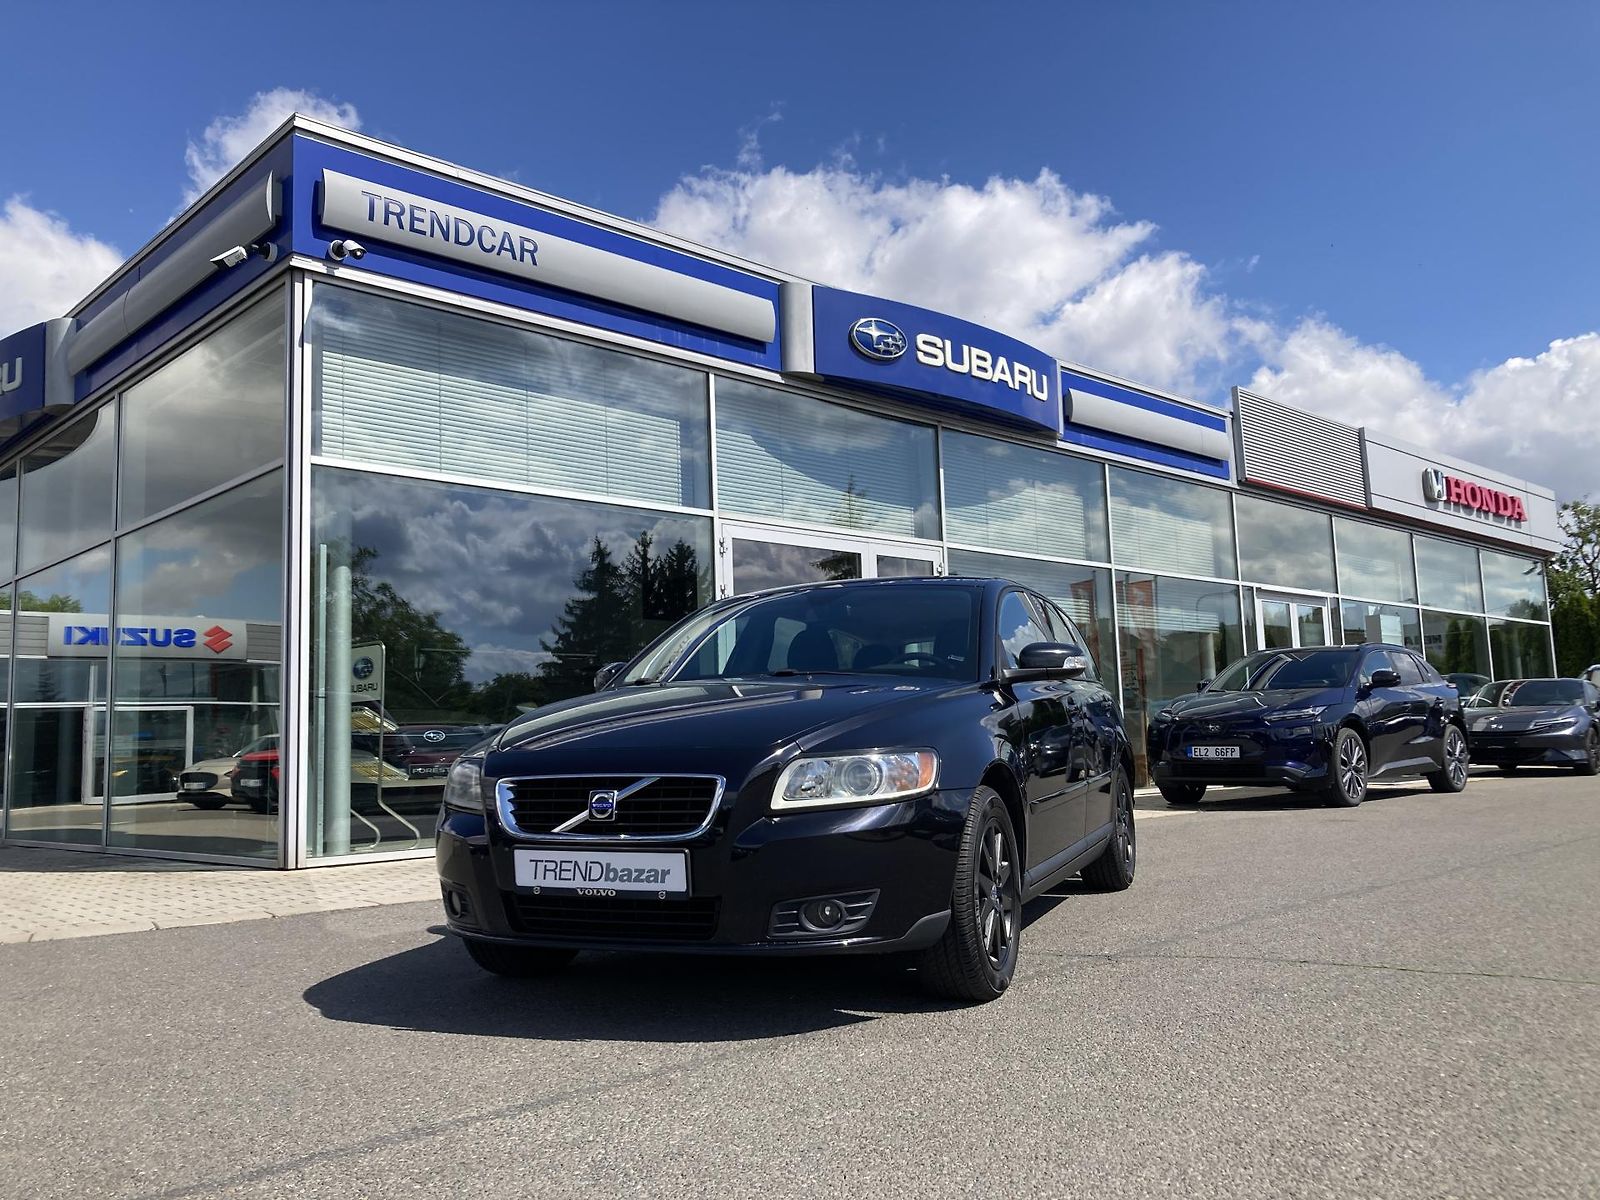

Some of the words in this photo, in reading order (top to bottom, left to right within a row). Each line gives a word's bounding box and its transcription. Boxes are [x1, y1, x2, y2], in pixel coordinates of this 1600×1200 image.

[361, 190, 539, 266] TRENDCAR
[916, 333, 1048, 401] SUBARU
[1444, 475, 1528, 522] HONDA
[351, 682, 378, 693] UBARU
[1193, 747, 1209, 757] EL2
[1214, 747, 1236, 757] 66FP
[529, 859, 671, 884] TRENDbazar
[576, 888, 617, 897] VOLVO
